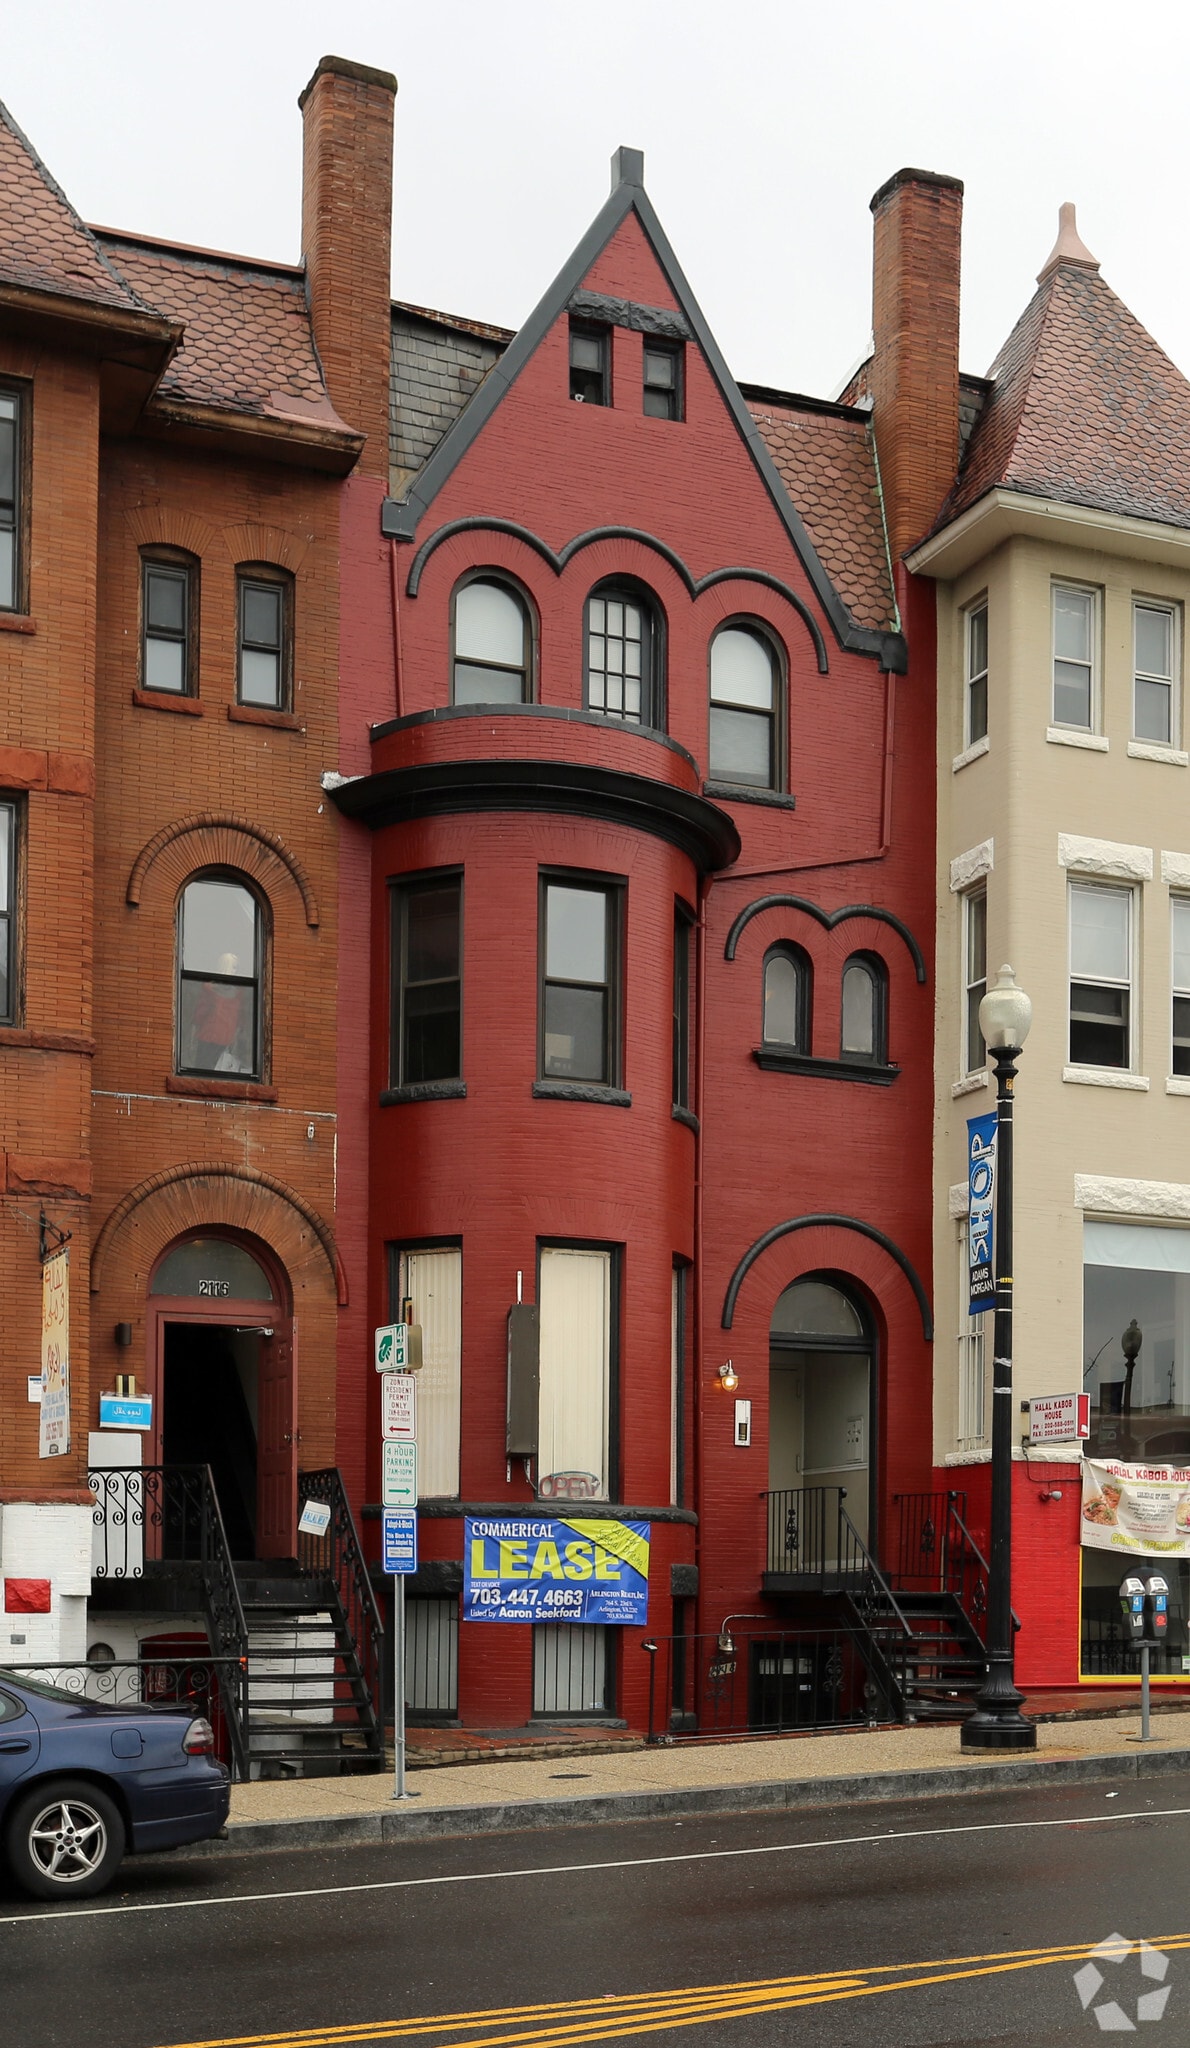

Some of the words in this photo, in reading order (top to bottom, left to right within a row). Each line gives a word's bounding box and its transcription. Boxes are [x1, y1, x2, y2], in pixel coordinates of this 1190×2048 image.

[971, 1132, 995, 1264] SHOP
[972, 1267, 989, 1282] ADAMS
[970, 1280, 993, 1296] MORGAN
[386, 1386, 412, 1394] RESIDENT
[389, 1394, 409, 1402] PERMIT
[391, 1401, 407, 1409] ONLY
[1035, 1402, 1052, 1412] HALAL
[1054, 1399, 1072, 1410] KABOB
[1044, 1410, 1062, 1420] HOUSE
[387, 1447, 391, 1455] 4
[394, 1448, 413, 1456] HOUR
[387, 1458, 413, 1467] PARKING
[1106, 1465, 1133, 1479] HALAL
[1136, 1470, 1168, 1480] KABOB
[539, 1476, 597, 1498] OPEN
[471, 1522, 555, 1538] COMMERICAL
[471, 1539, 621, 1580] LEASE
[470, 1588, 583, 1606] 703.447.4663
[471, 1609, 487, 1617] Listed
[488, 1610, 496, 1619] by
[498, 1607, 532, 1618] Aaron
[535, 1607, 581, 1618] Seekford
